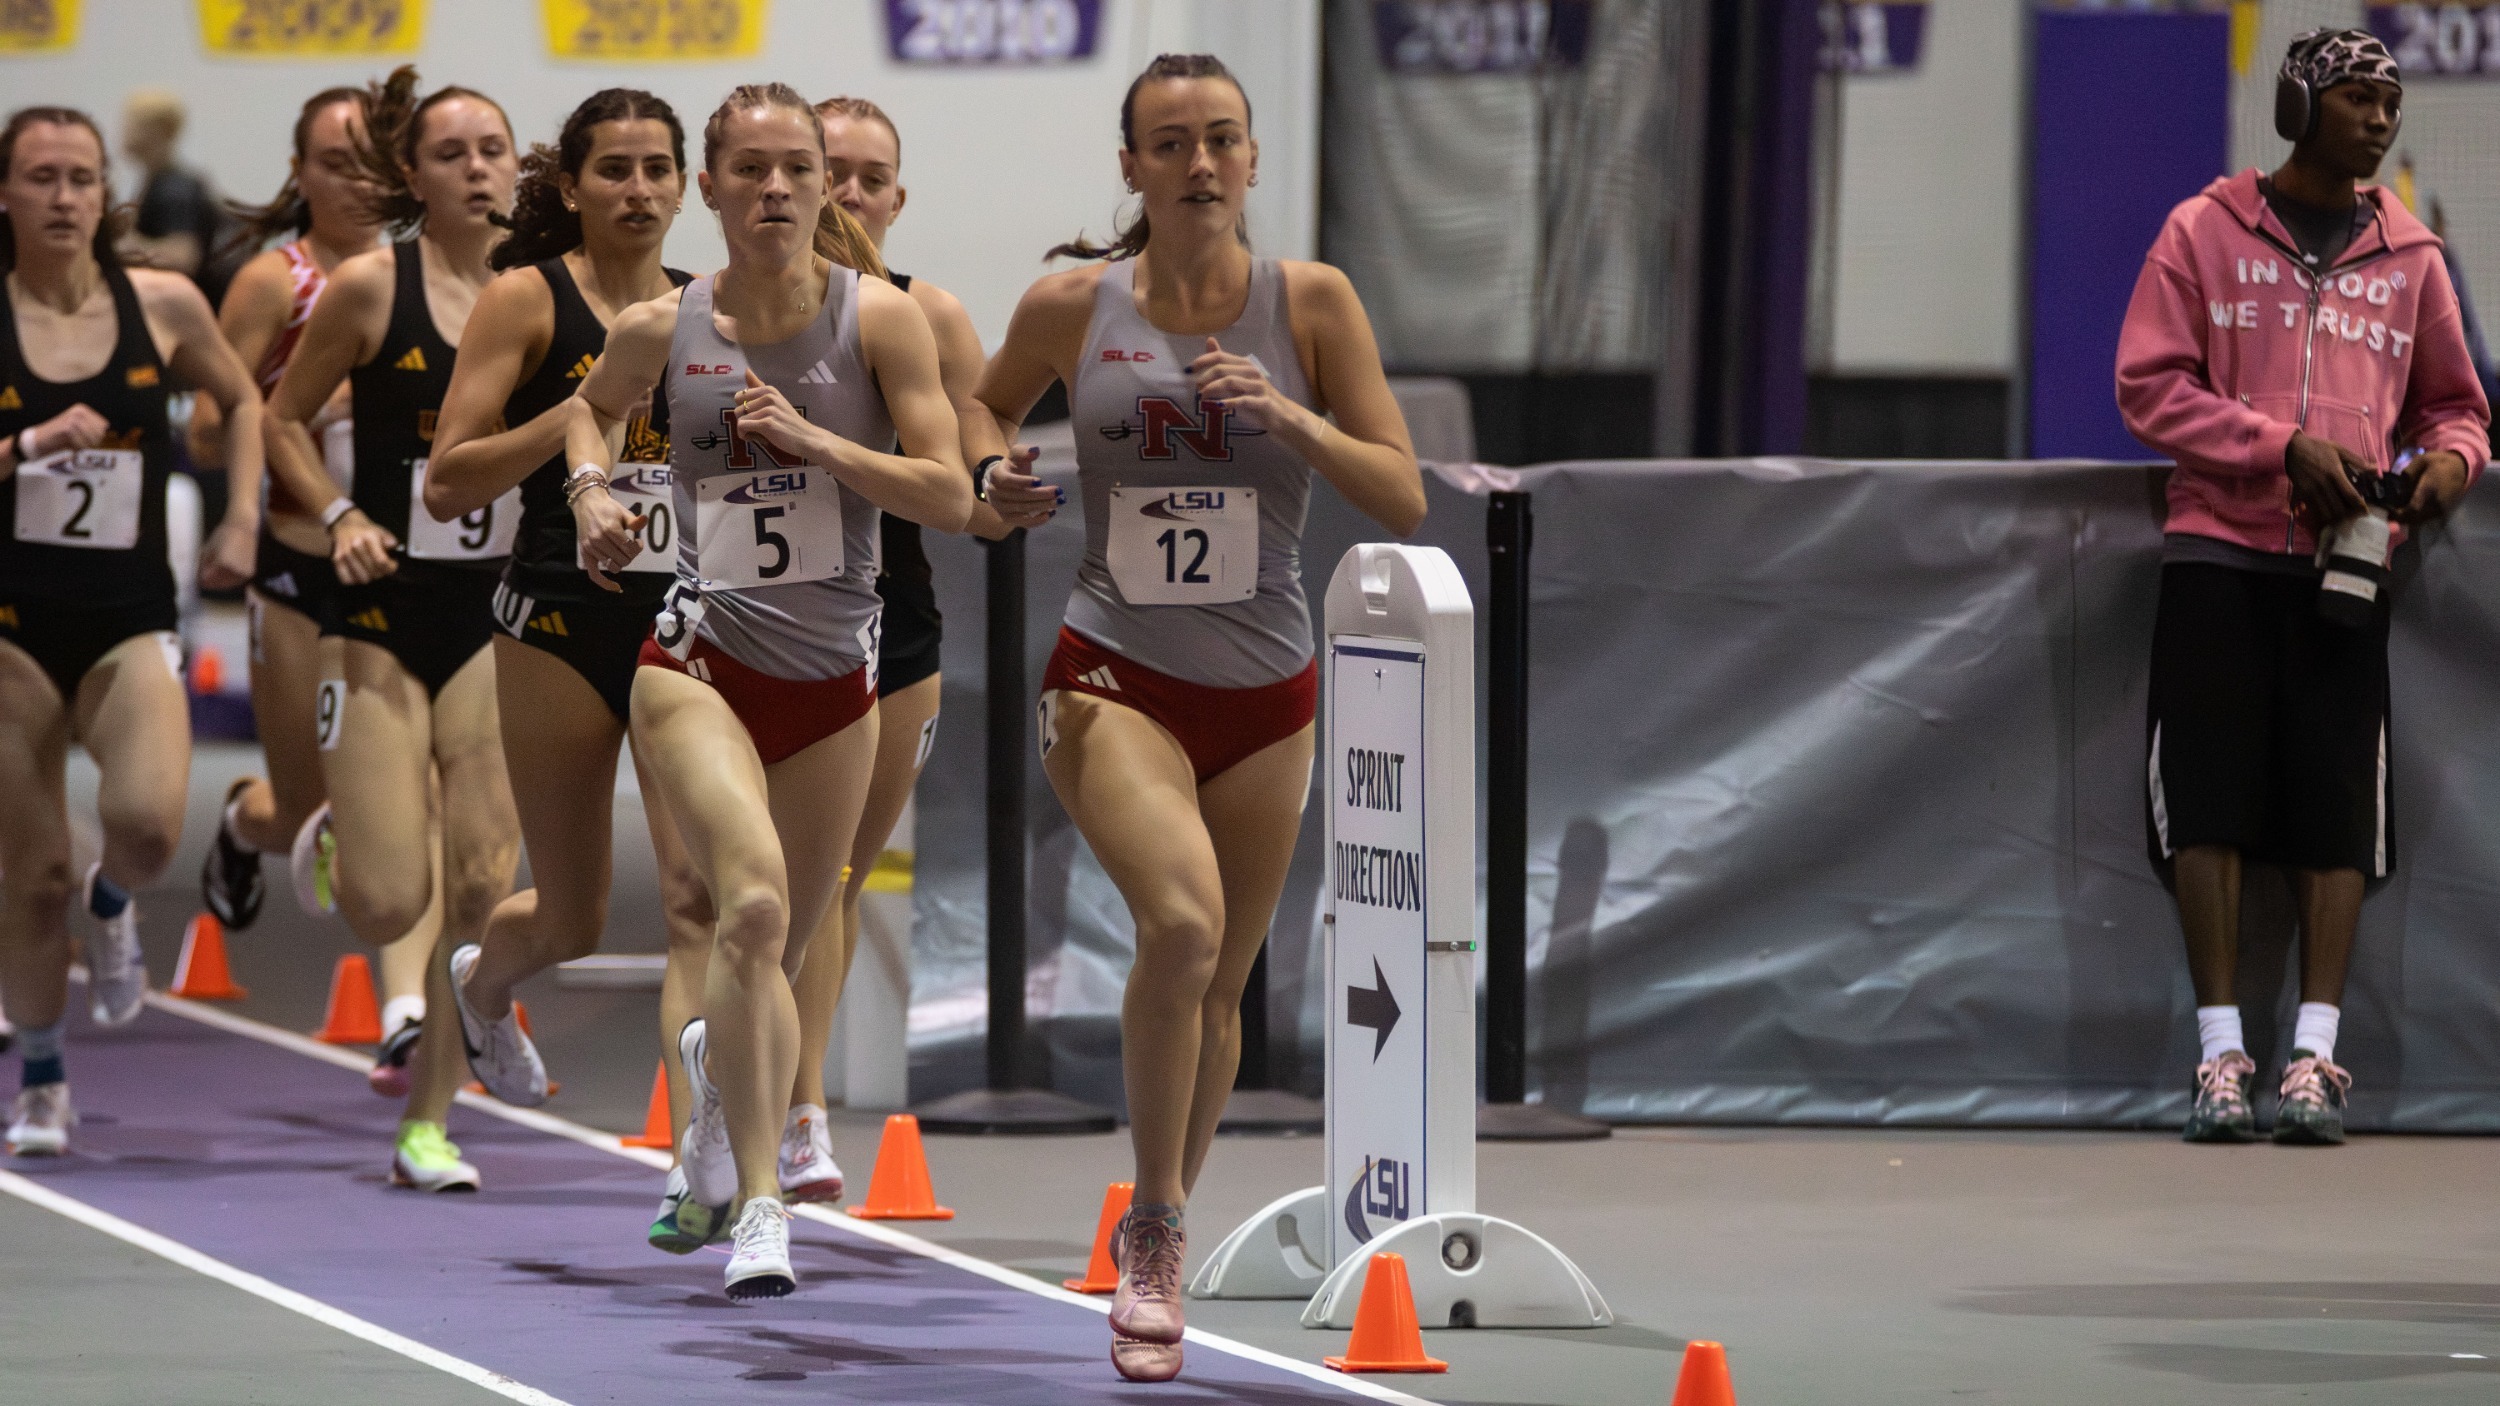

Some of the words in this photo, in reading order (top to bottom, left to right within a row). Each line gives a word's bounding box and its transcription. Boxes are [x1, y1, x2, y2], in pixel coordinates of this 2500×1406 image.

[901, 0, 1080, 58] 2010
[2237, 257, 2278, 284] IN
[1101, 350, 1155, 362] SLC
[2209, 300, 2258, 329] WE
[2279, 302, 2412, 358] TRUST
[685, 363, 733, 375] SLC
[1136, 395, 1235, 462] N
[61, 481, 94, 538] 2
[752, 472, 806, 494] LSU
[1168, 491, 1225, 510] LSU
[458, 502, 493, 550] 9
[753, 506, 791, 578] 5
[1156, 529, 1211, 584] 12
[658, 585, 701, 648] 5
[320, 684, 336, 744] 9
[1347, 746, 1405, 813] SPRINT
[1336, 840, 1421, 912] DIRECTION
[1365, 1154, 1410, 1222] LSU
